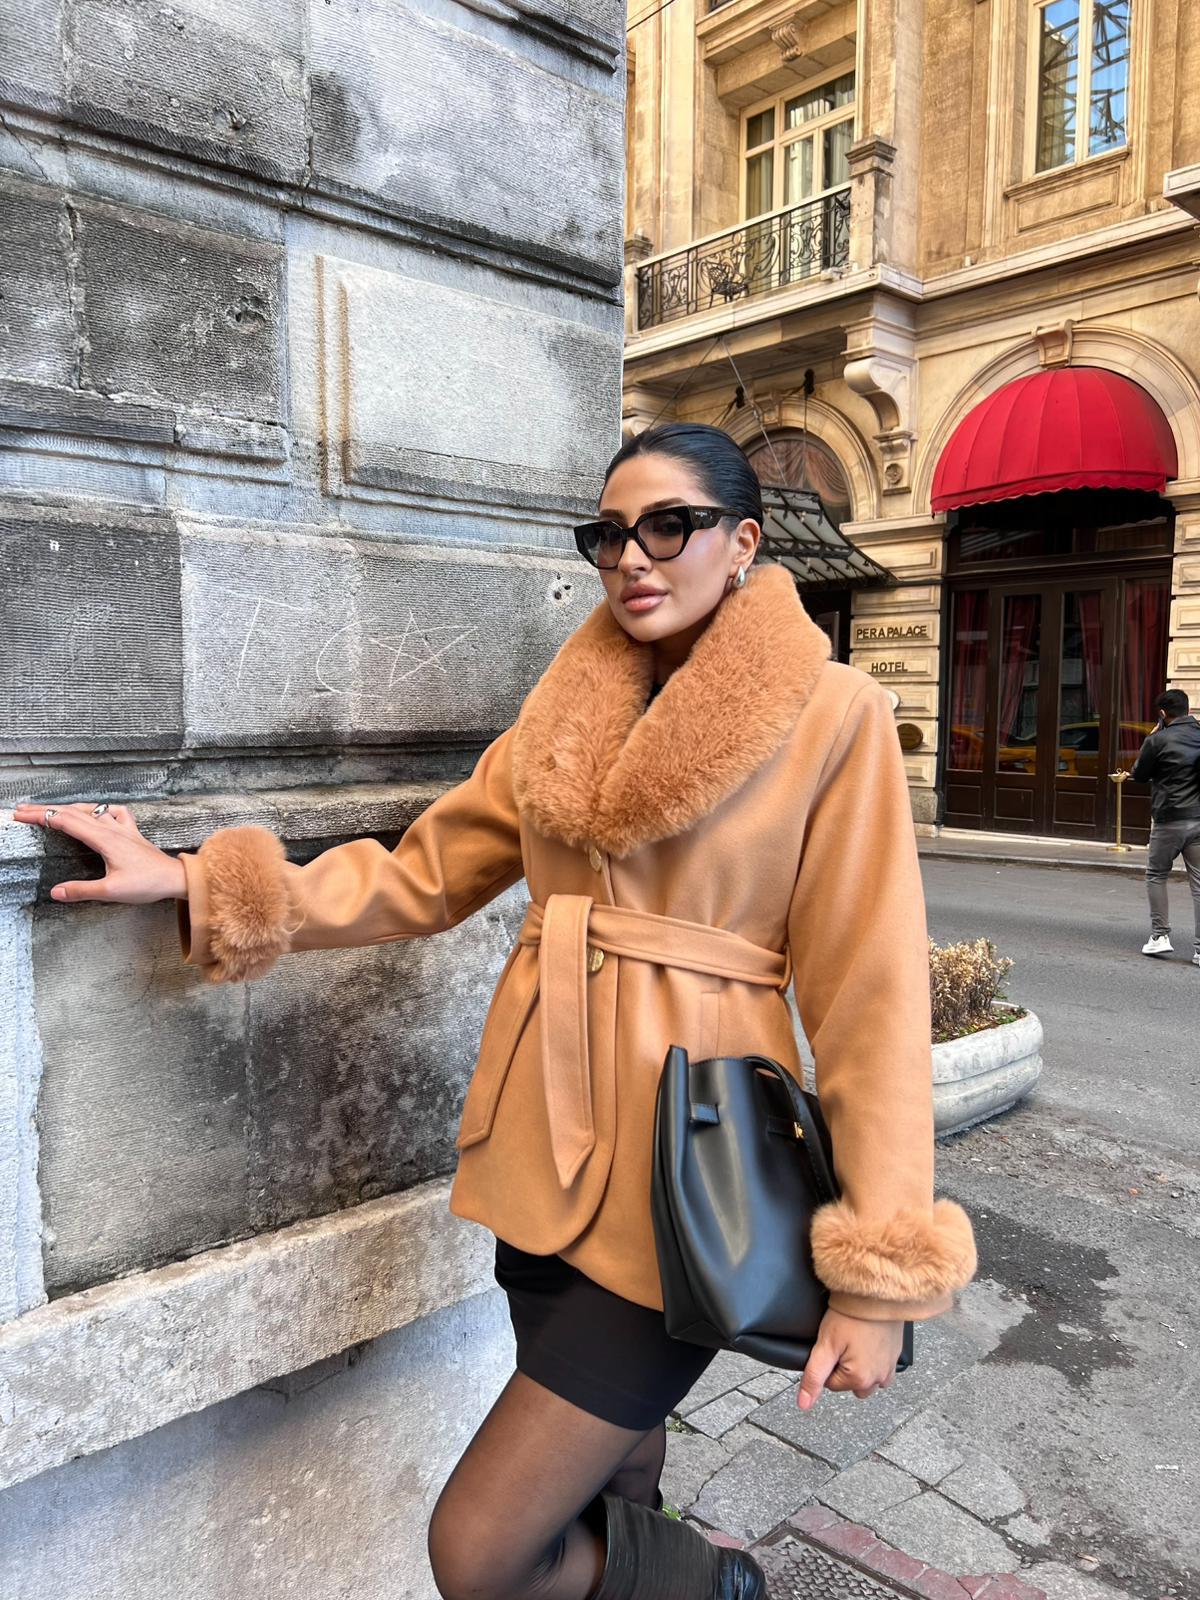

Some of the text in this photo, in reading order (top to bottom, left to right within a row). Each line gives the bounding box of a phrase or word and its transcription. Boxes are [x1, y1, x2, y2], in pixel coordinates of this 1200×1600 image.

[856, 625, 927, 639] PERA PALACE
[871, 661, 908, 673] HOTEL
